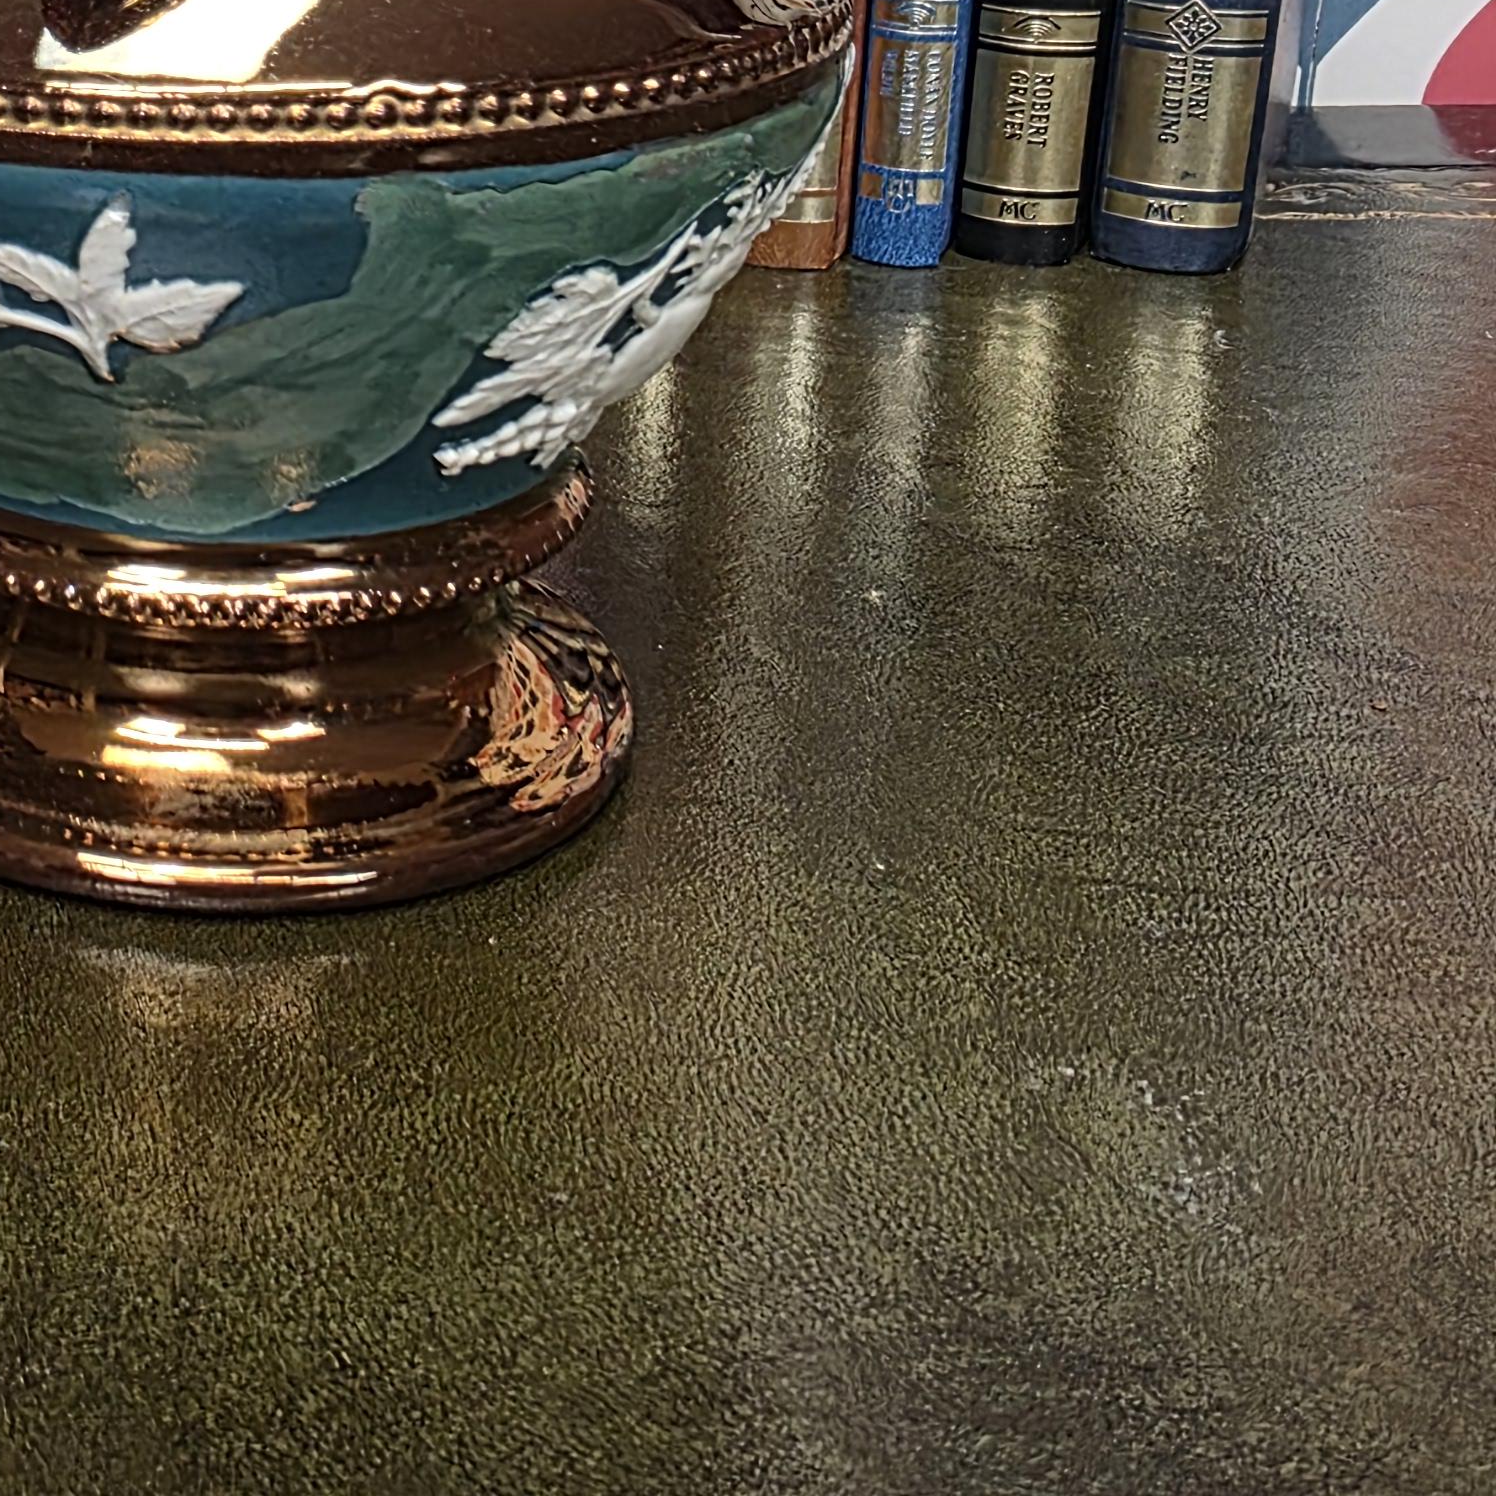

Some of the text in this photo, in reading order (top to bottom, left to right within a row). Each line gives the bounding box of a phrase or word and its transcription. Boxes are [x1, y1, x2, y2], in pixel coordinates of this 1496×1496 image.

[1004, 70, 1030, 141] GRAVES
[1027, 72, 1055, 148] ROBERT
[1158, 52, 1188, 145] FIELDING
[1188, 55, 1215, 122] HENRY
[998, 198, 1041, 221] MC
[1144, 199, 1190, 222] MC
